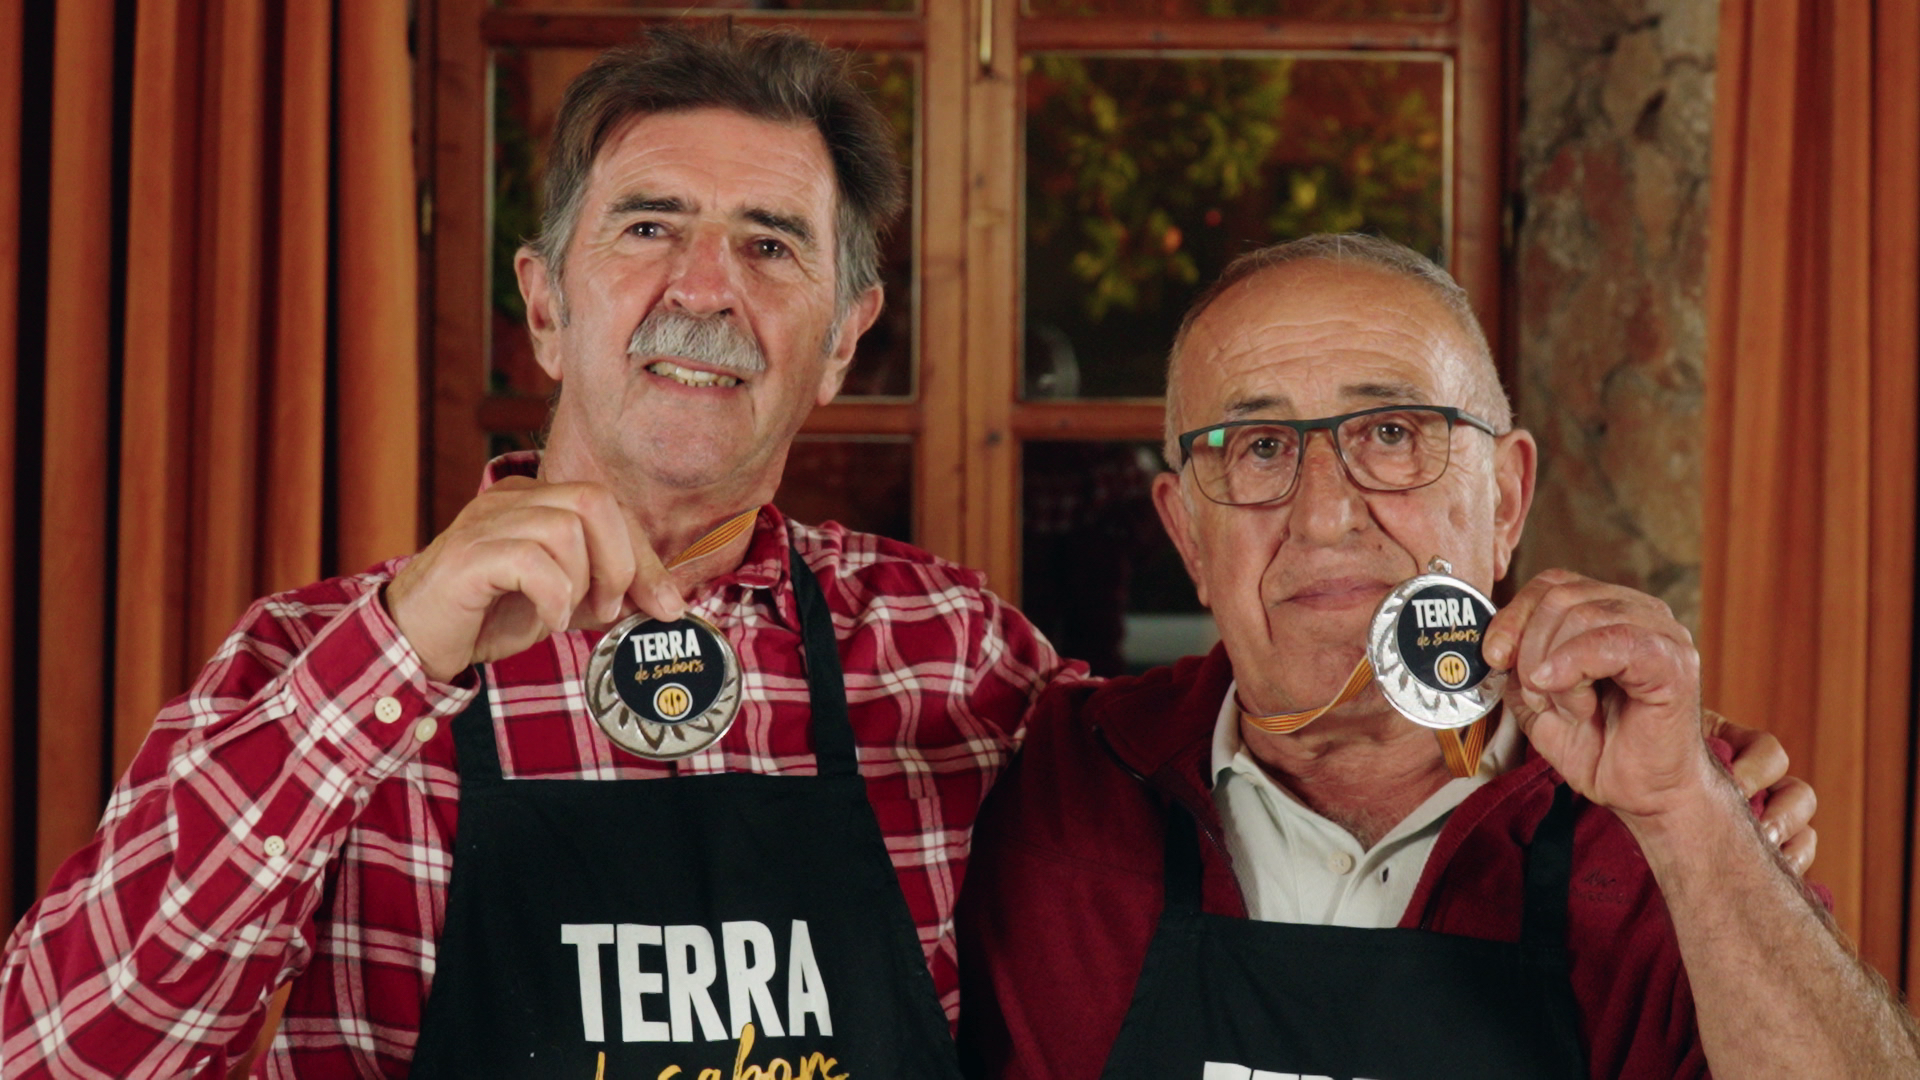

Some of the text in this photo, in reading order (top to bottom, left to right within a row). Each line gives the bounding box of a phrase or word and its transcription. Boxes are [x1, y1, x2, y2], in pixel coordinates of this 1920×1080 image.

[1411, 597, 1477, 628] TERRA
[629, 628, 702, 663] TERRA
[1417, 624, 1480, 650] de sabors
[634, 655, 705, 685] de sabors
[561, 919, 833, 1043] TERRA
